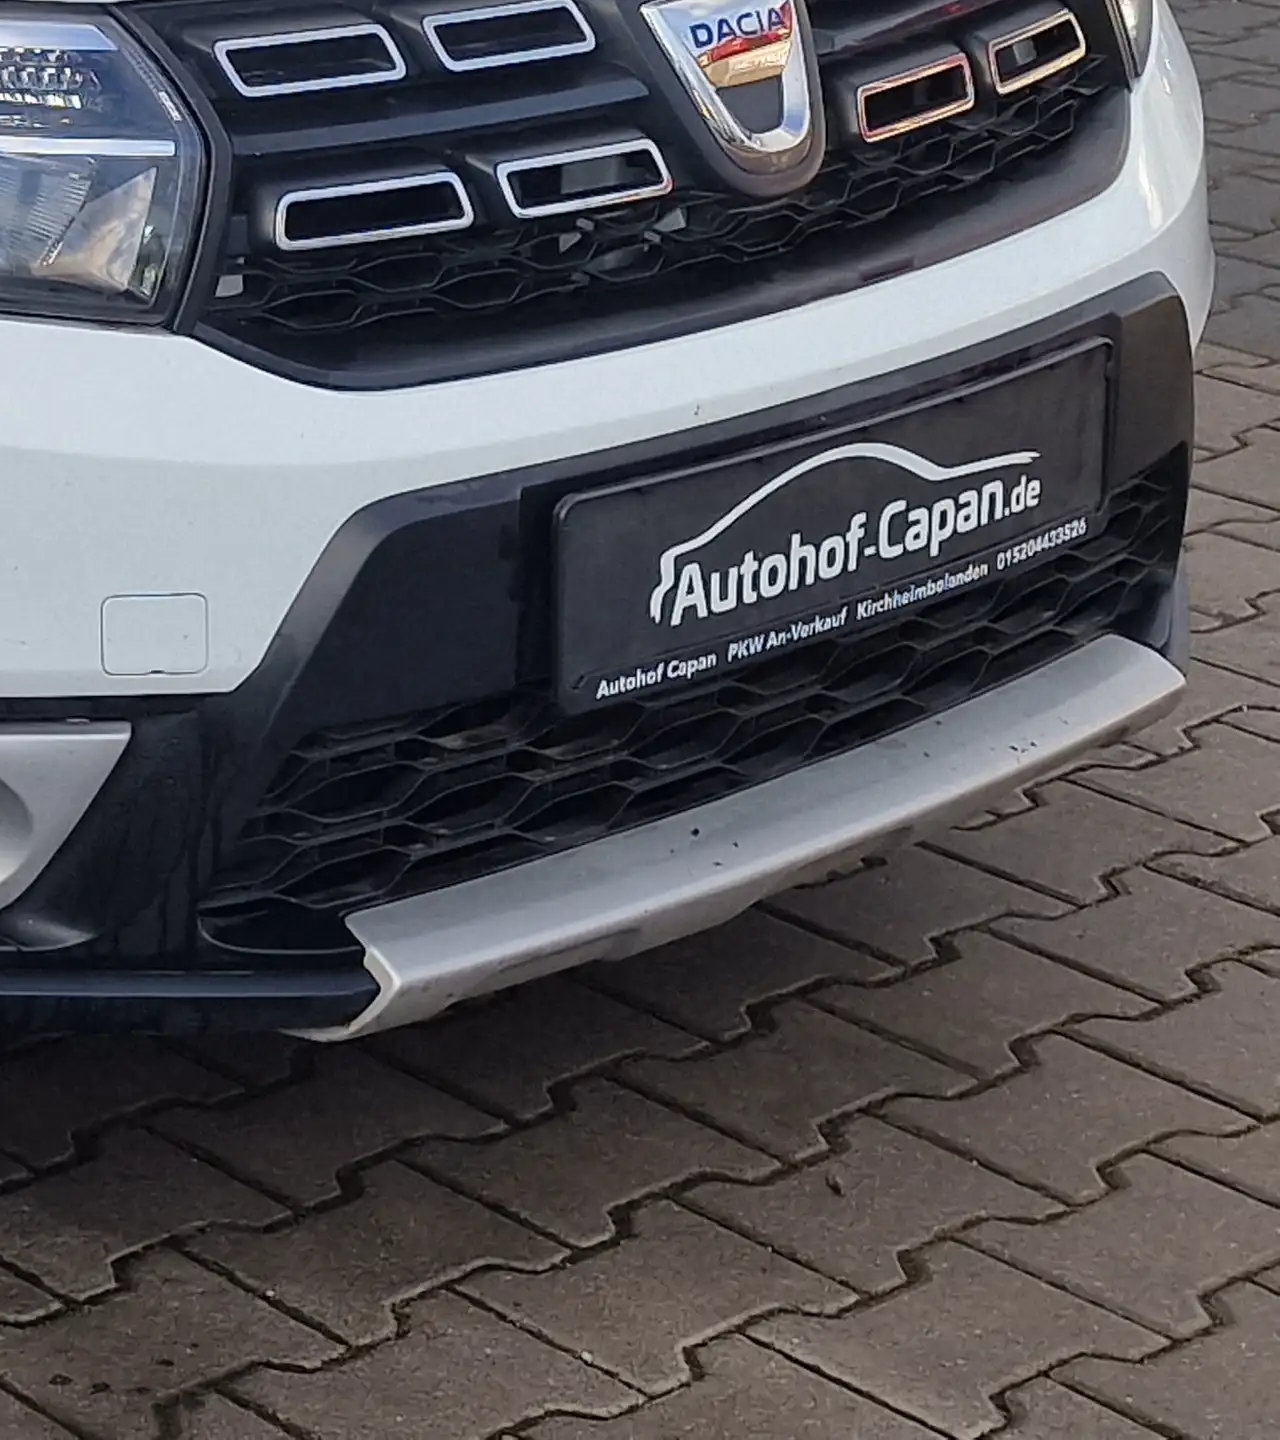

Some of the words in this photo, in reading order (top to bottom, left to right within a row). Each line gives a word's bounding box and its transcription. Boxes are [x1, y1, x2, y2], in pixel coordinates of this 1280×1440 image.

[688, 6, 786, 49] DACIA
[670, 472, 1042, 627] Autohof-Capan.de
[595, 661, 665, 700] Autohof
[666, 652, 718, 680] Capan
[727, 635, 765, 663] PKW
[766, 606, 849, 650] An-Verkauf
[856, 563, 989, 620] Kirchheimbolanden
